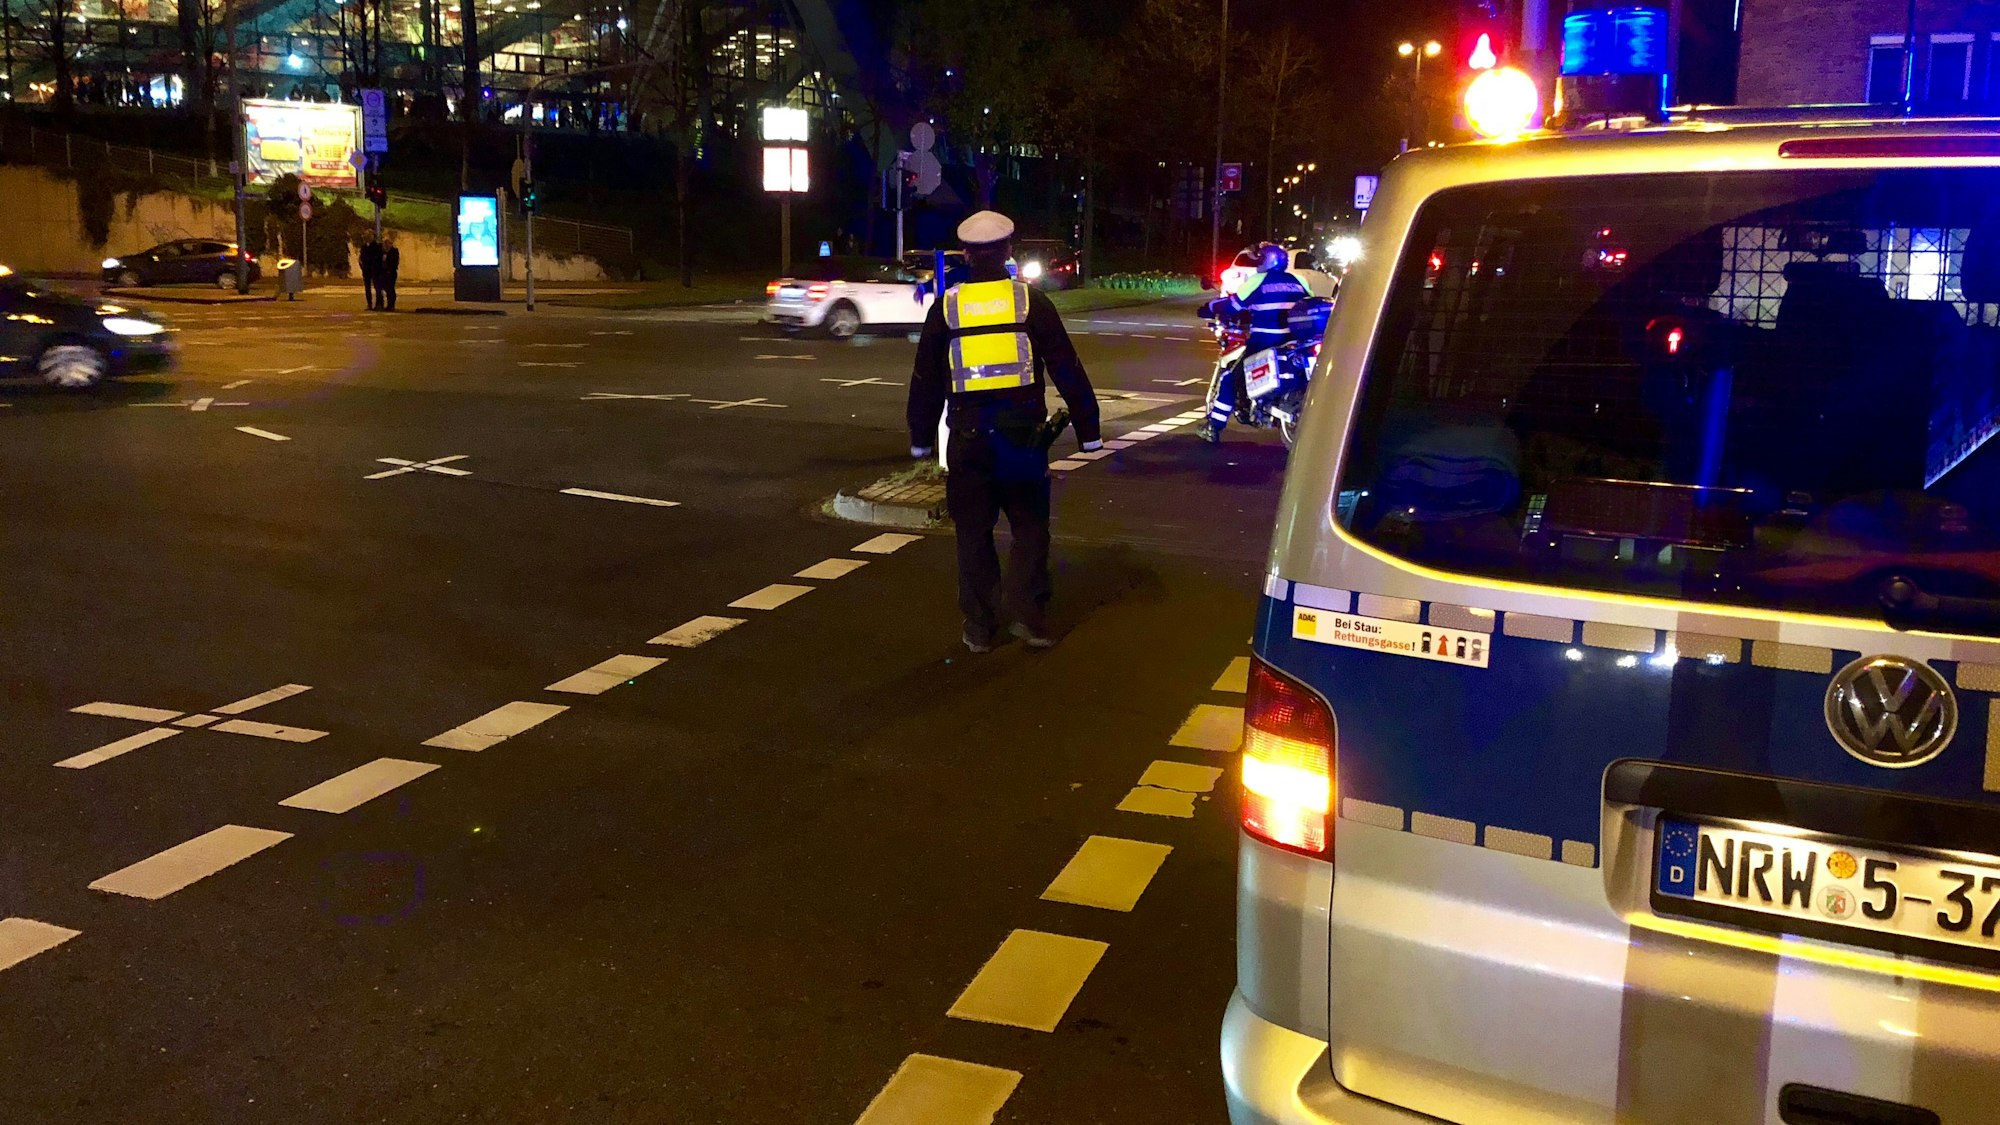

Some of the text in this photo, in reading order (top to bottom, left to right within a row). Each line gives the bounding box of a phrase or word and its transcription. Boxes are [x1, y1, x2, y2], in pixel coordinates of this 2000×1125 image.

[1298, 613, 1316, 623] ADAC
[1335, 618, 1382, 634] Bei Stau:
[1334, 630, 1416, 652] Rettungsgasse!
[1836, 662, 1948, 758] VW
[1669, 865, 1684, 883] D
[1698, 834, 1817, 909] NRW
